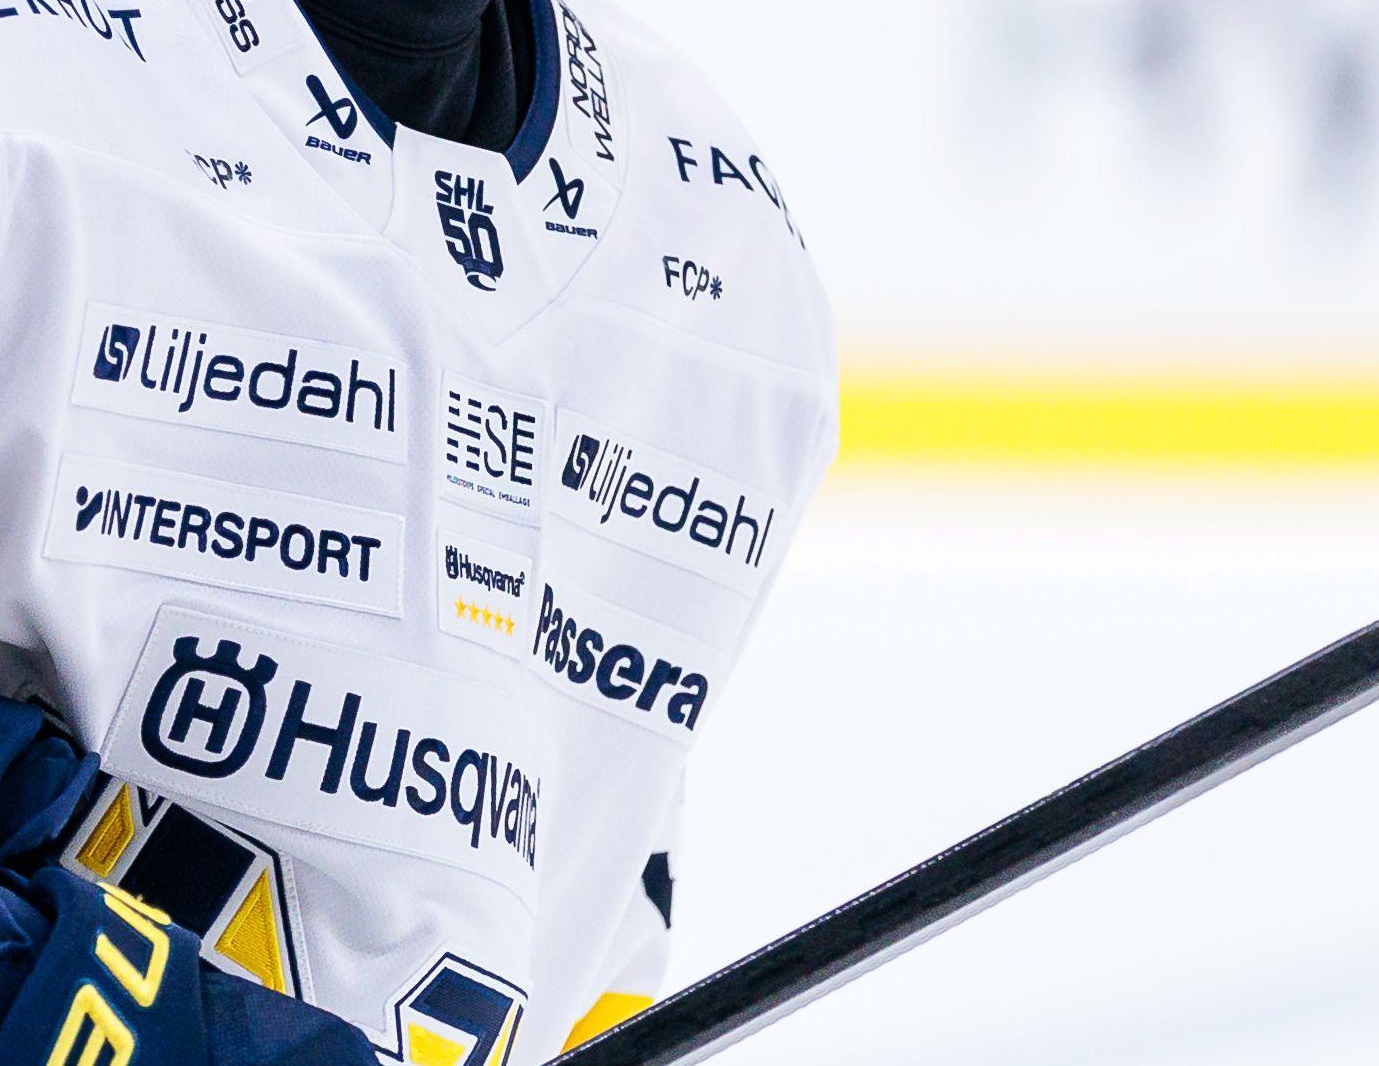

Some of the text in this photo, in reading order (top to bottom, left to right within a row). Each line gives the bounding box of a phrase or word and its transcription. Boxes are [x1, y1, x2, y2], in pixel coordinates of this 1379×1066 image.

[434, 170, 494, 215] SHL
[436, 201, 504, 279] 50
[101, 489, 382, 582] INTERSPORT
[533, 582, 709, 732] Passera
